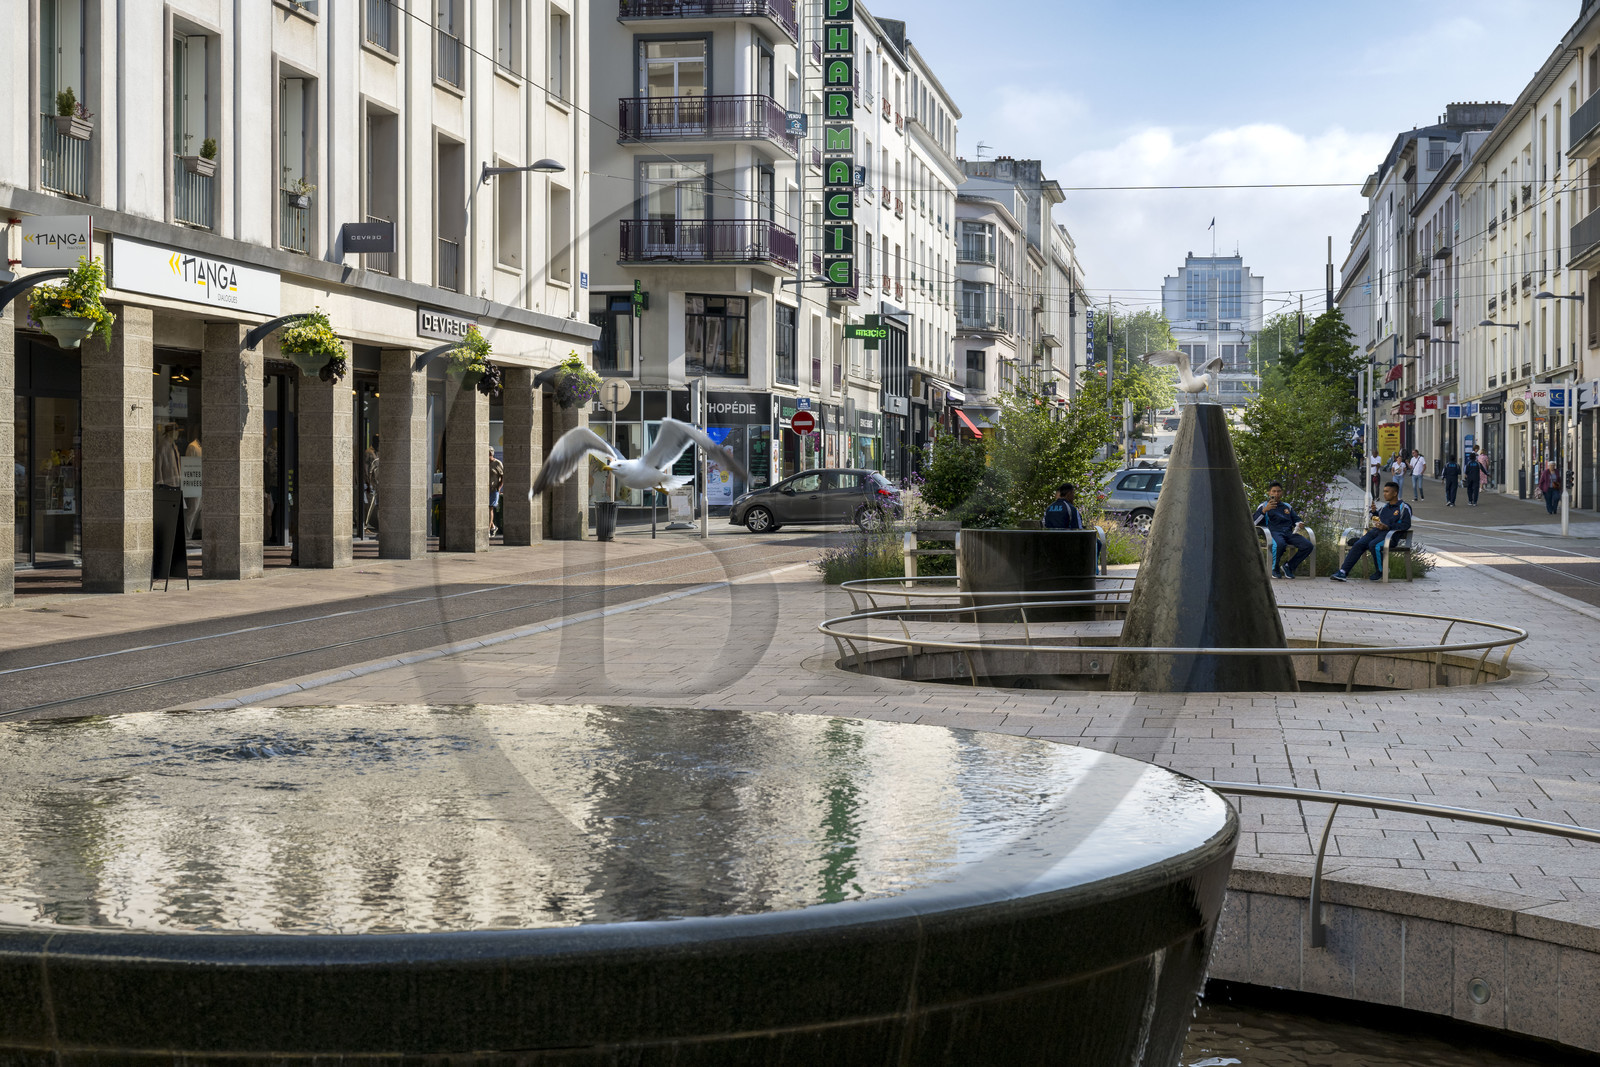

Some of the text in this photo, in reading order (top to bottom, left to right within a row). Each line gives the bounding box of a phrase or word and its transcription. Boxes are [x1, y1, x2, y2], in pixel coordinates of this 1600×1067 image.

[827, 0, 851, 284] PHARMACIE
[35, 233, 86, 249] MANGA
[182, 254, 238, 299] MANGA
[217, 293, 238, 304] DIALOGUES
